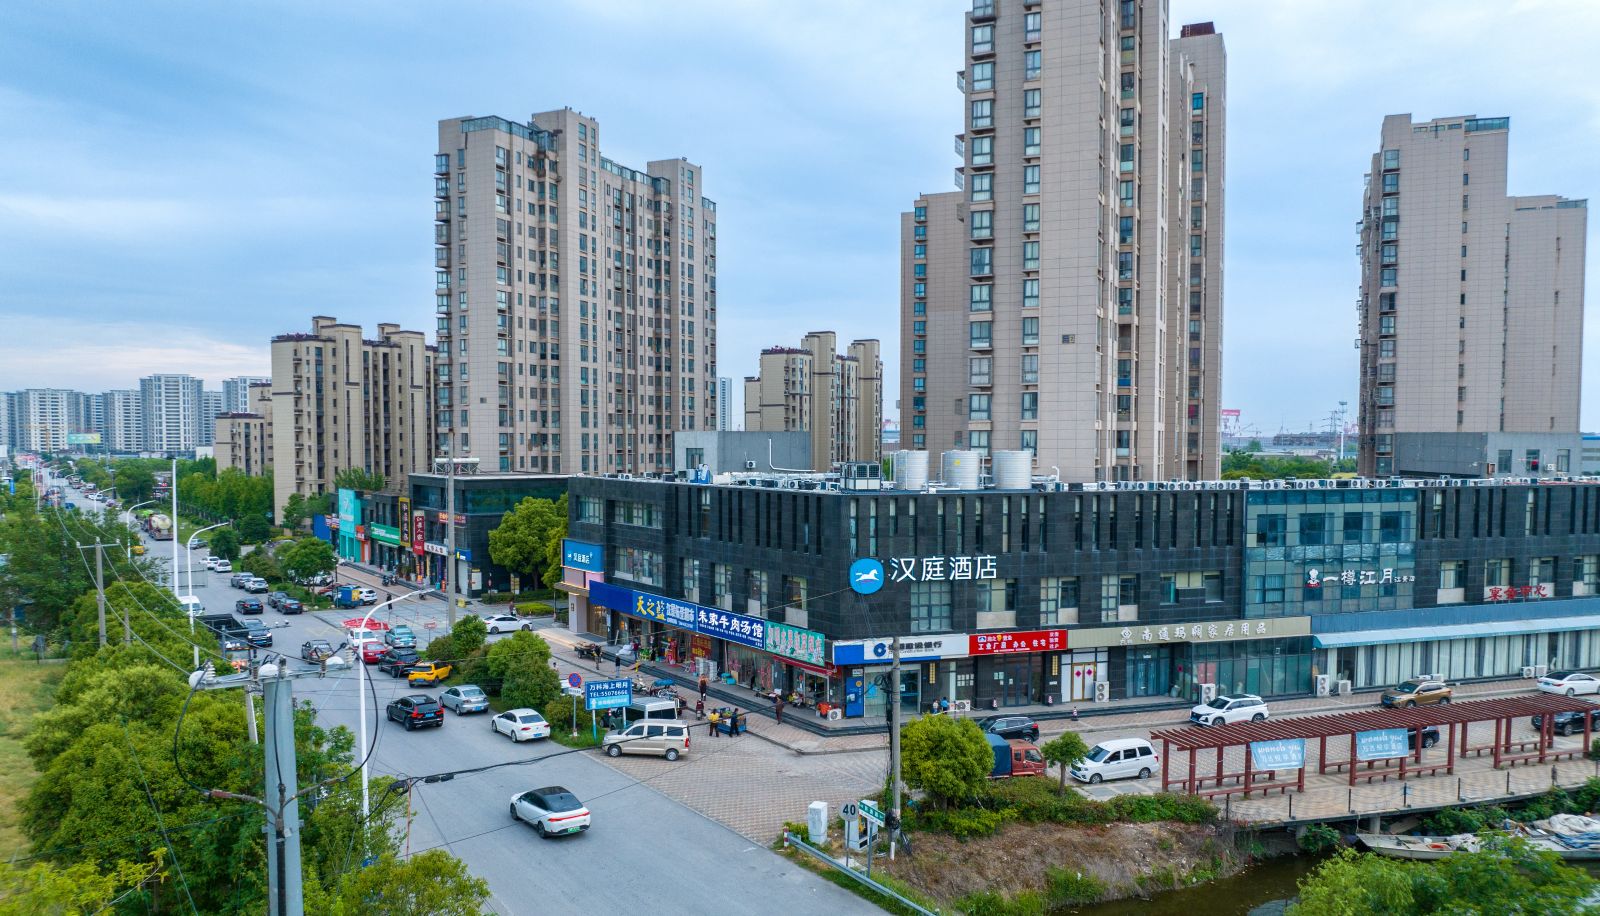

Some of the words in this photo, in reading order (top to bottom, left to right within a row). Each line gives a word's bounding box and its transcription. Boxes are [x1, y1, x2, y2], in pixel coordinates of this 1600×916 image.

[890, 555, 997, 582] 汉庭酒店
[1323, 568, 1393, 585] 一樽江月
[698, 610, 763, 638] 朱家牛肉汤馆
[589, 681, 628, 691] 万科海上明月
[843, 804, 856, 815] 40
